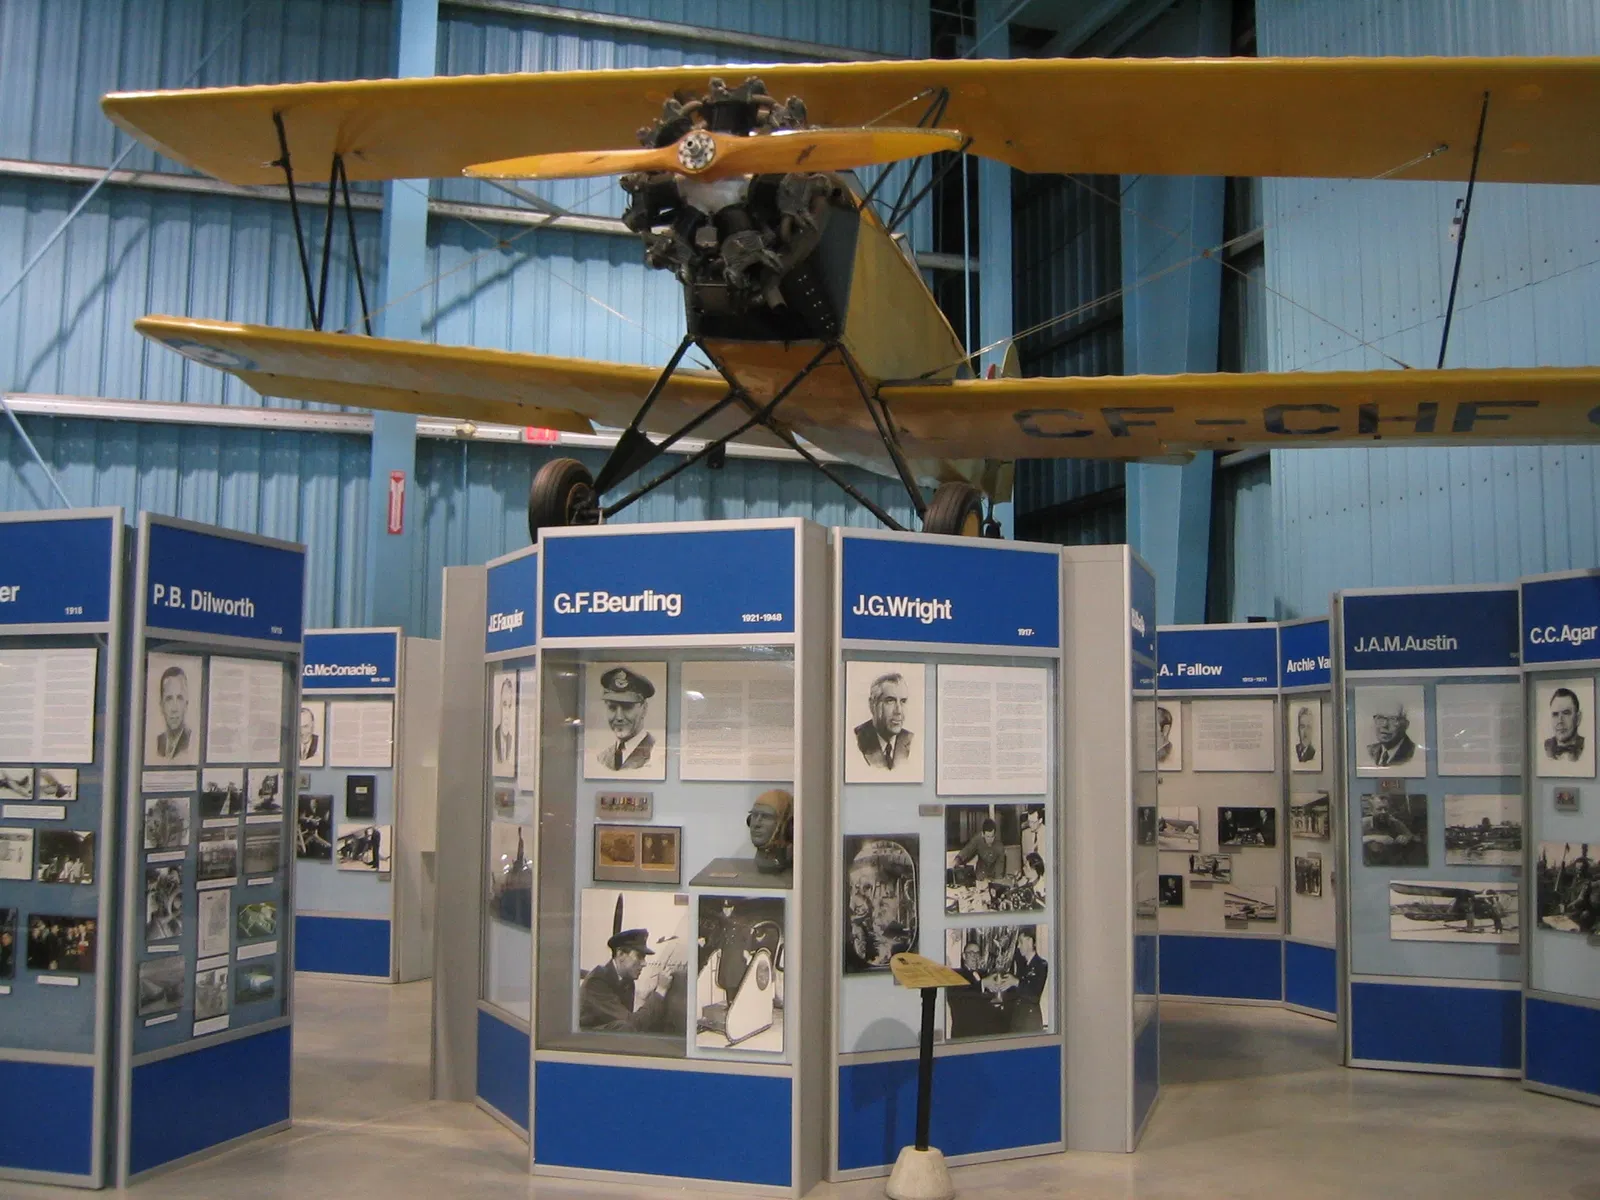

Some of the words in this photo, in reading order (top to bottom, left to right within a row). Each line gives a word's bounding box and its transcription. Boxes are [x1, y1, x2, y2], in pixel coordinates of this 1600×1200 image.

[1013, 400, 1540, 438] CF-CHF
[153, 583, 186, 609] P.B.
[191, 589, 255, 618] Dilworth
[553, 590, 682, 617] G.F.Beurling
[853, 594, 953, 624] J.G.Wright
[742, 613, 783, 622] 1921-1948
[1354, 635, 1458, 652] J.A.M.Austin
[1530, 624, 1598, 646] C.C.Agar
[1177, 663, 1223, 676] Fallow
[1286, 656, 1316, 673] Archie
